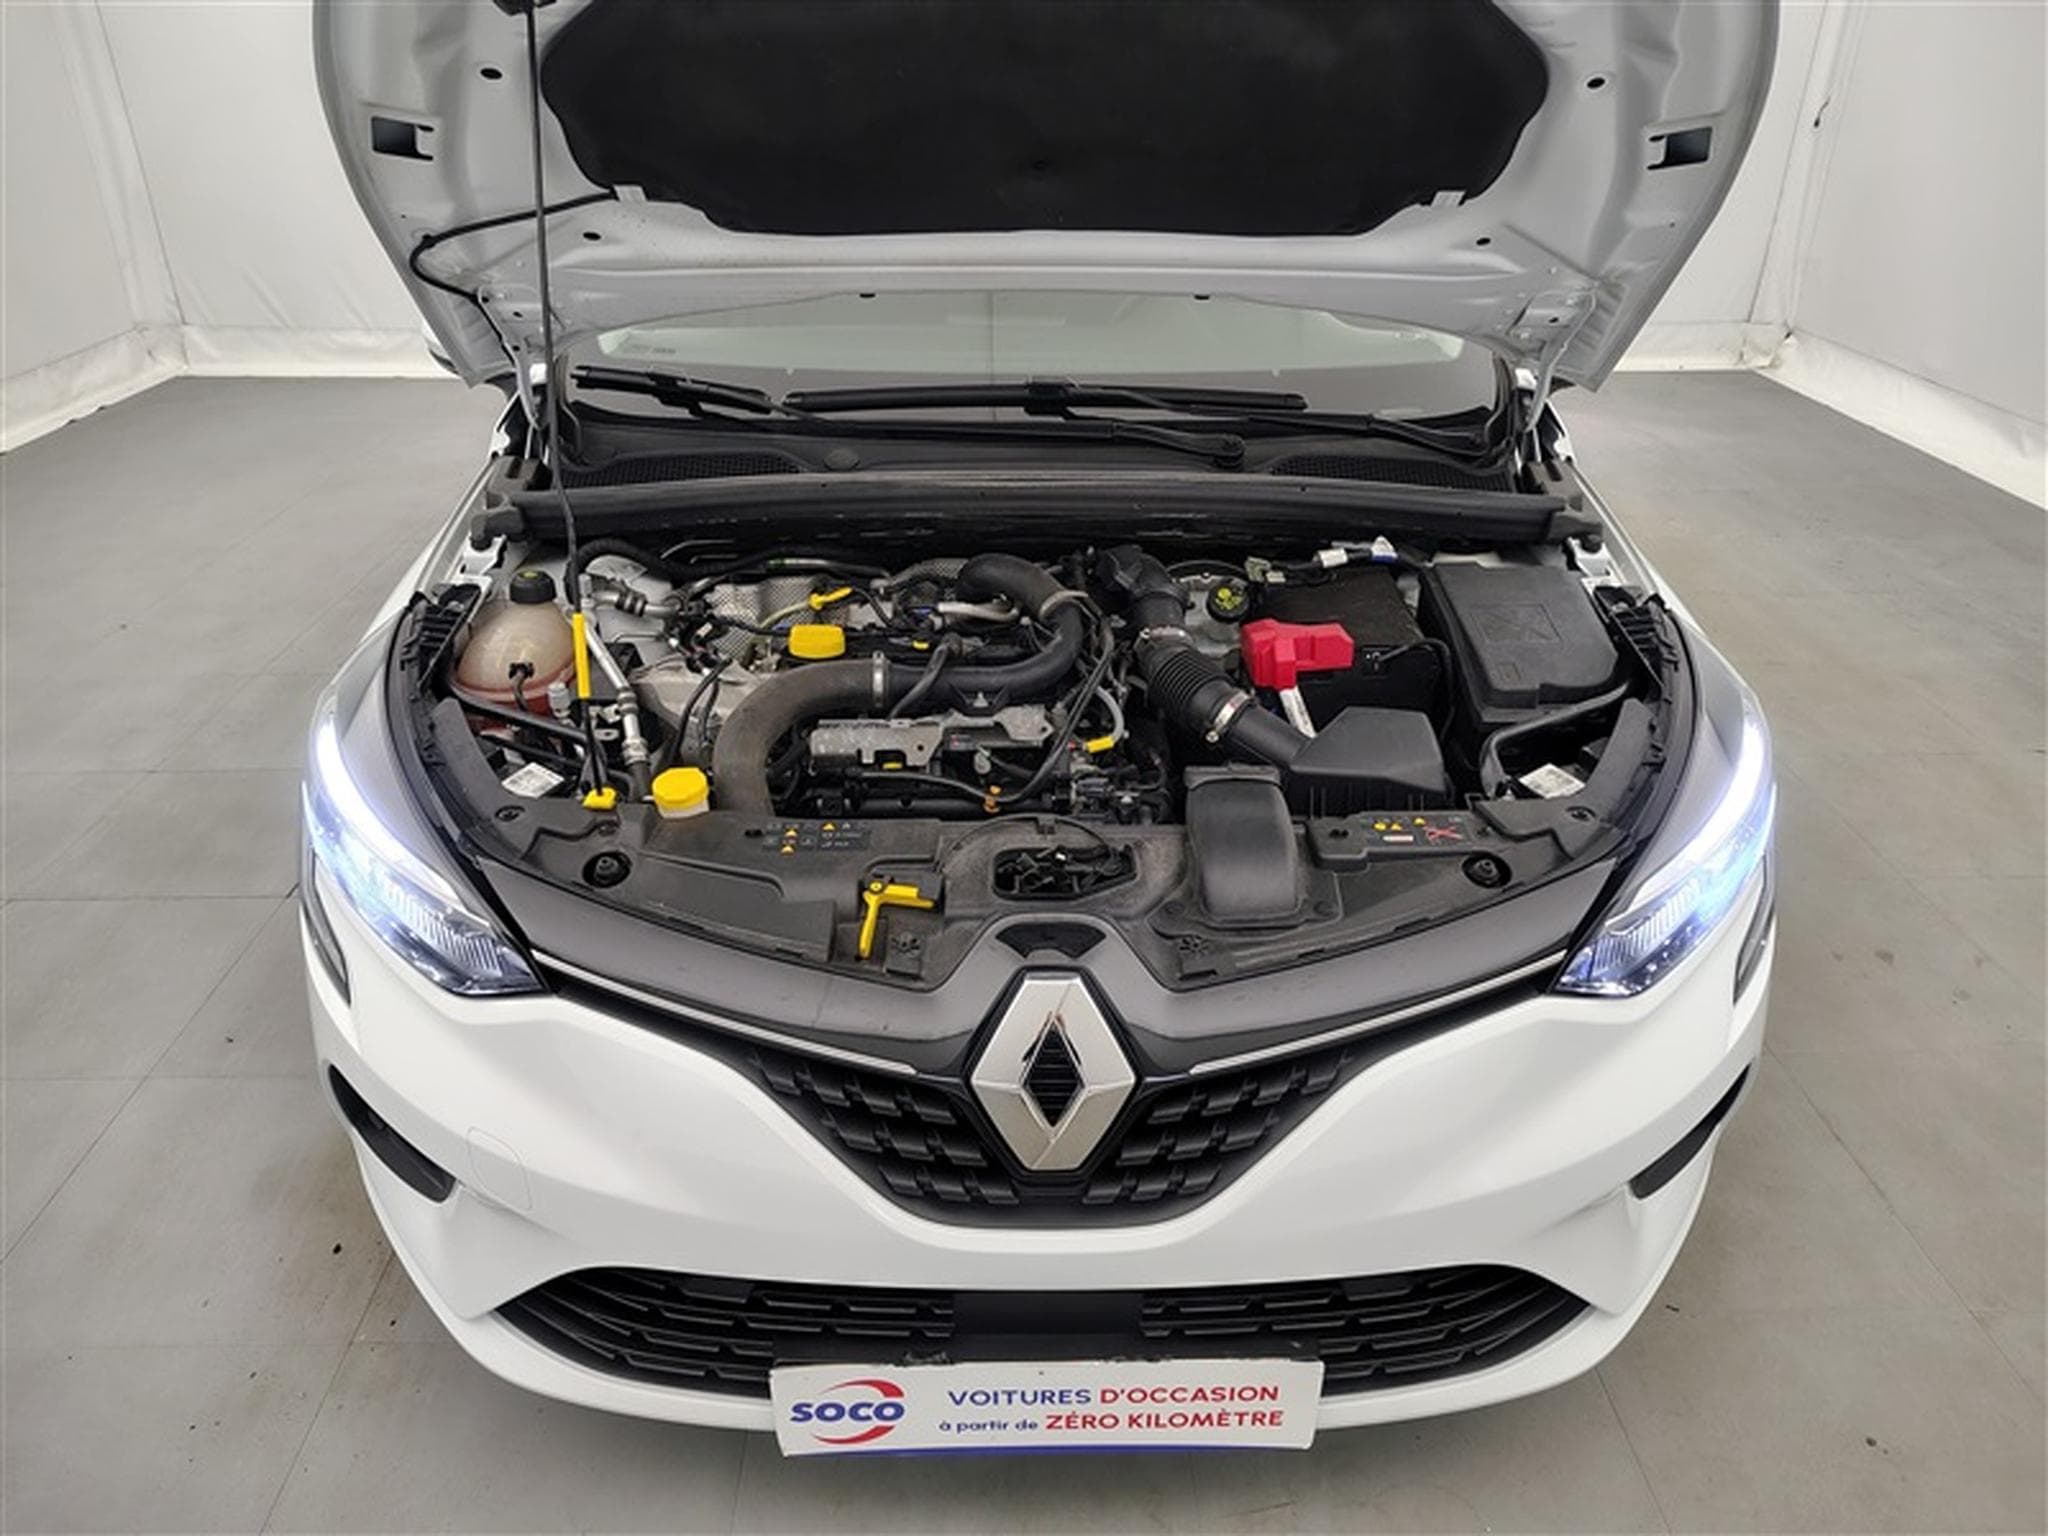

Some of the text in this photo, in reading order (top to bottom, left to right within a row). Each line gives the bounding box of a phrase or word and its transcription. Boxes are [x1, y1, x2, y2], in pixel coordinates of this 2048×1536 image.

[948, 1385, 1279, 1406] VOITURES D'OCCASION
[790, 1402, 905, 1422] SOCO
[939, 1408, 1284, 1434] à partir de ZÉRO KILOMÈTRE
